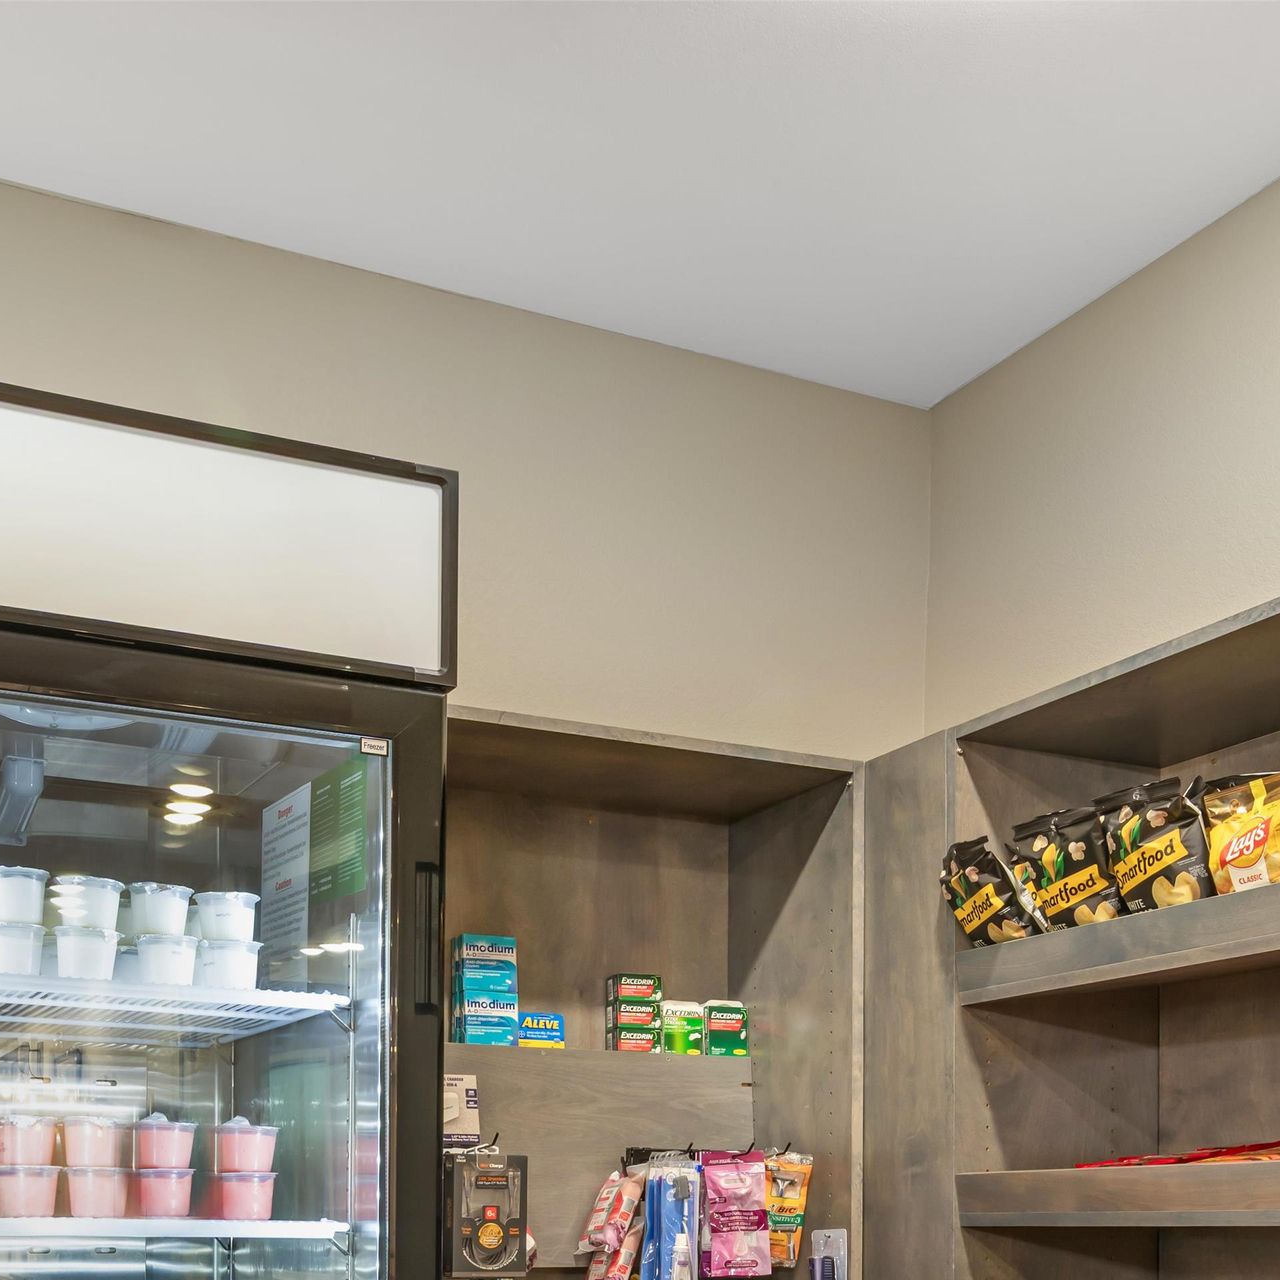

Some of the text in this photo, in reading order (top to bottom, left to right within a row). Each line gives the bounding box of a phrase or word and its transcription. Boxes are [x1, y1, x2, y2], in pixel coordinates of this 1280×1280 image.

[363, 742, 385, 751] Freezer
[1224, 823, 1266, 861] Lay's
[1116, 839, 1175, 890] Smartfood
[1238, 873, 1263, 885] CLASSIC
[960, 894, 992, 928] martfood
[465, 943, 514, 954] Imodium
[622, 977, 653, 985] EXCEDRIN
[467, 1000, 515, 1010] Imodium
[621, 1004, 653, 1013] EXCEDRIN
[522, 1017, 559, 1029] ALEVE
[621, 1032, 653, 1040] EXCEDRIN
